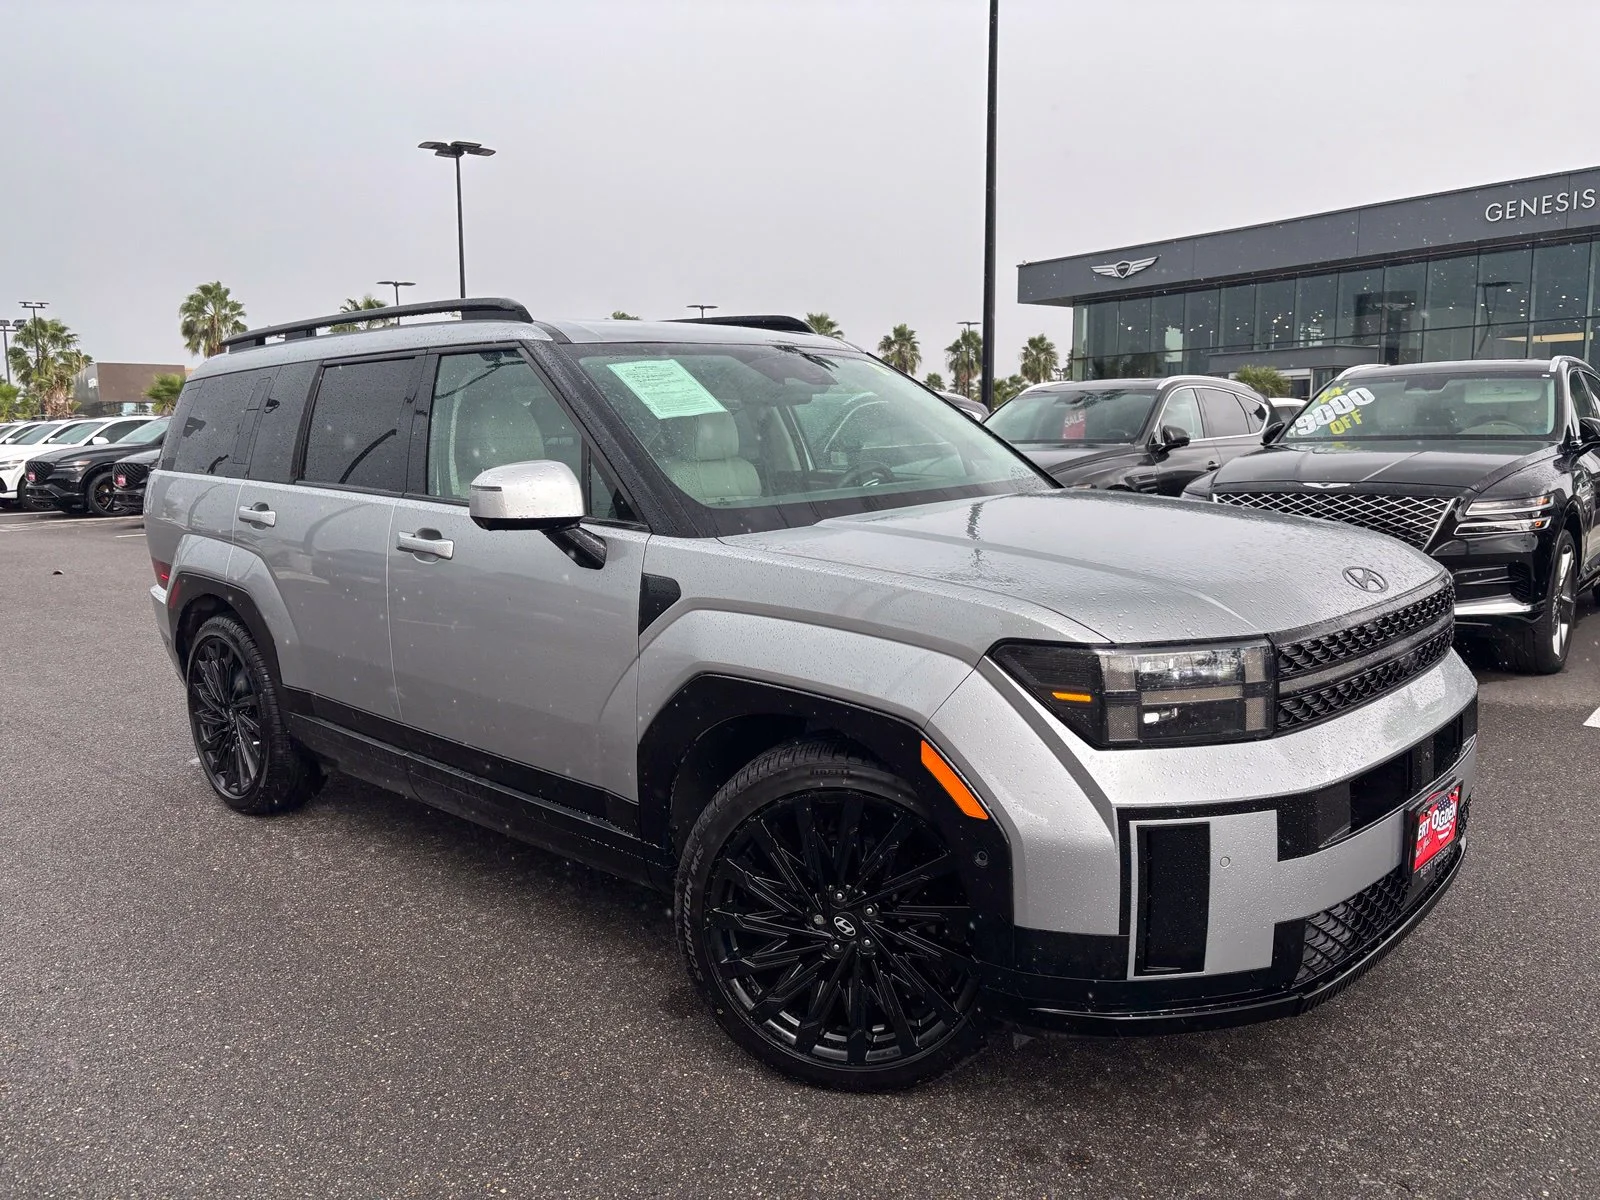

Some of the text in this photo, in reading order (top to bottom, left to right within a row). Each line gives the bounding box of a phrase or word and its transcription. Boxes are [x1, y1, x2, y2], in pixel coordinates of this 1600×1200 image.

[1485, 188, 1596, 222] GENESIS
[1064, 410, 1085, 428] SALE
[1329, 409, 1363, 435] OFF
[1418, 802, 1457, 841] ERT OGDEN
